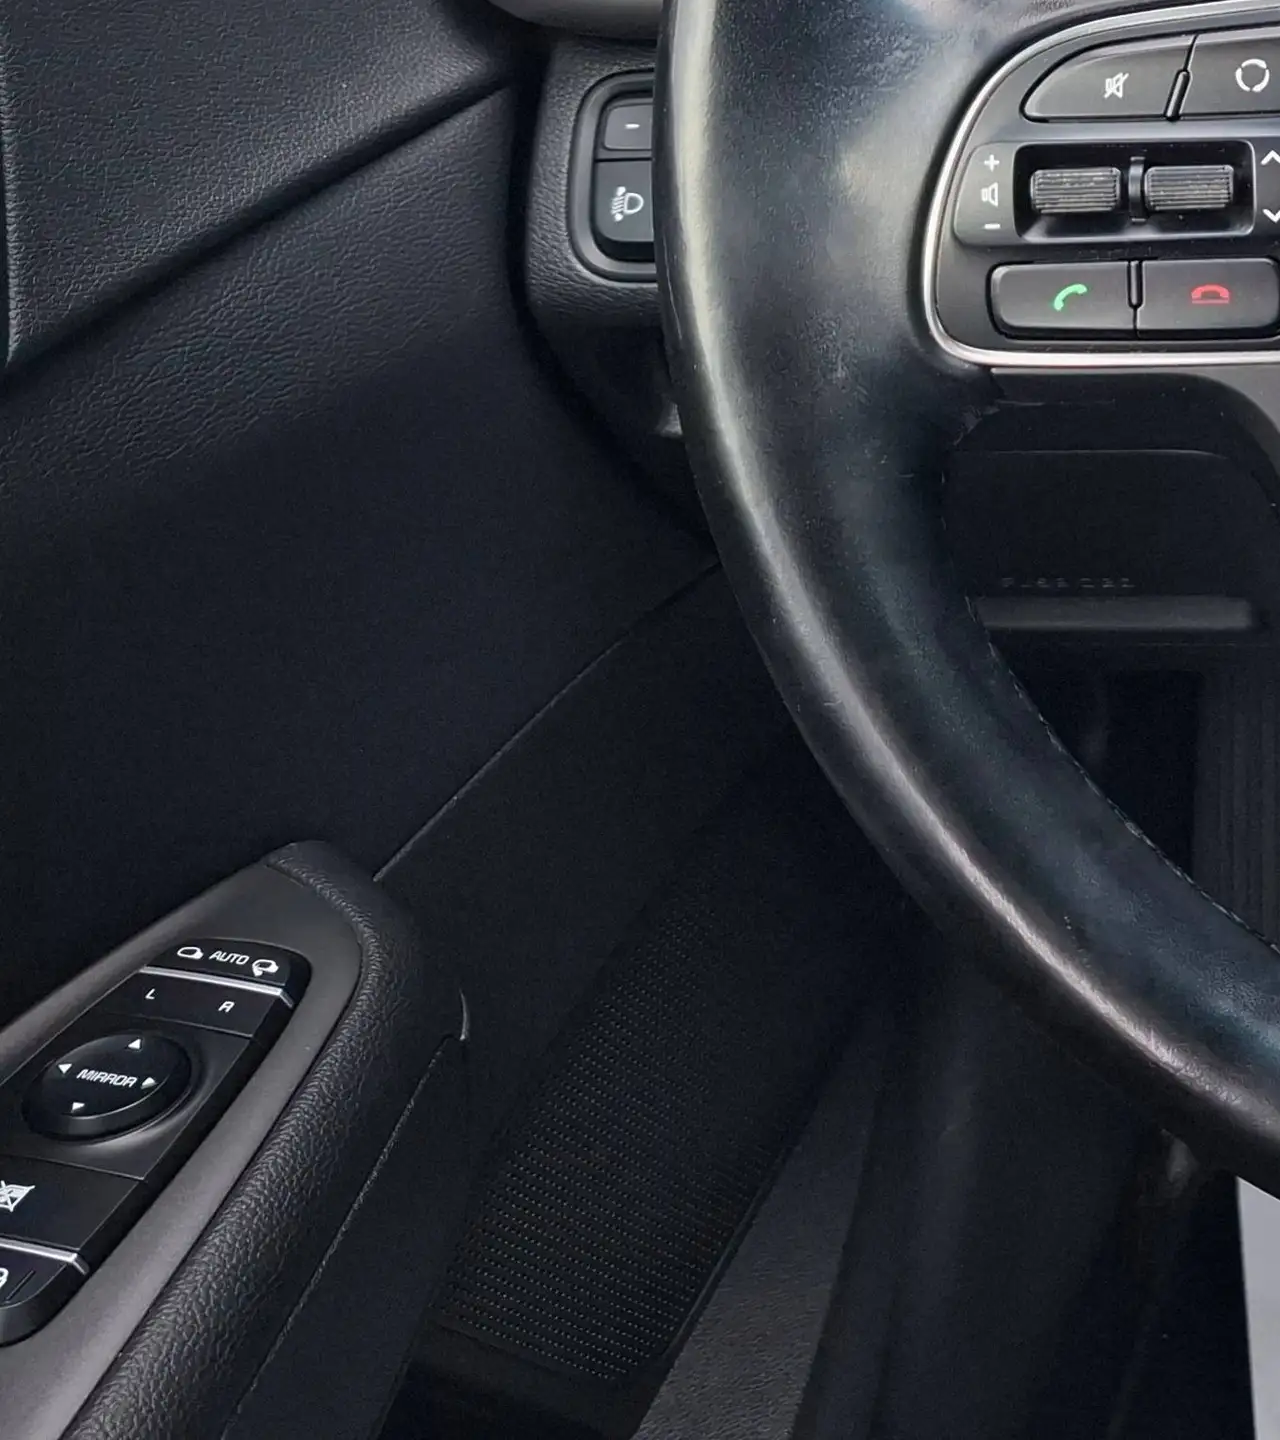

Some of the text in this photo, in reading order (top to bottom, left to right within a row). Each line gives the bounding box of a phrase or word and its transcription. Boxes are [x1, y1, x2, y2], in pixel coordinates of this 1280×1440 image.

[209, 951, 249, 965] AUTO
[145, 989, 156, 1000] L
[218, 1001, 234, 1013] R
[77, 1068, 138, 1087] MIRROR
